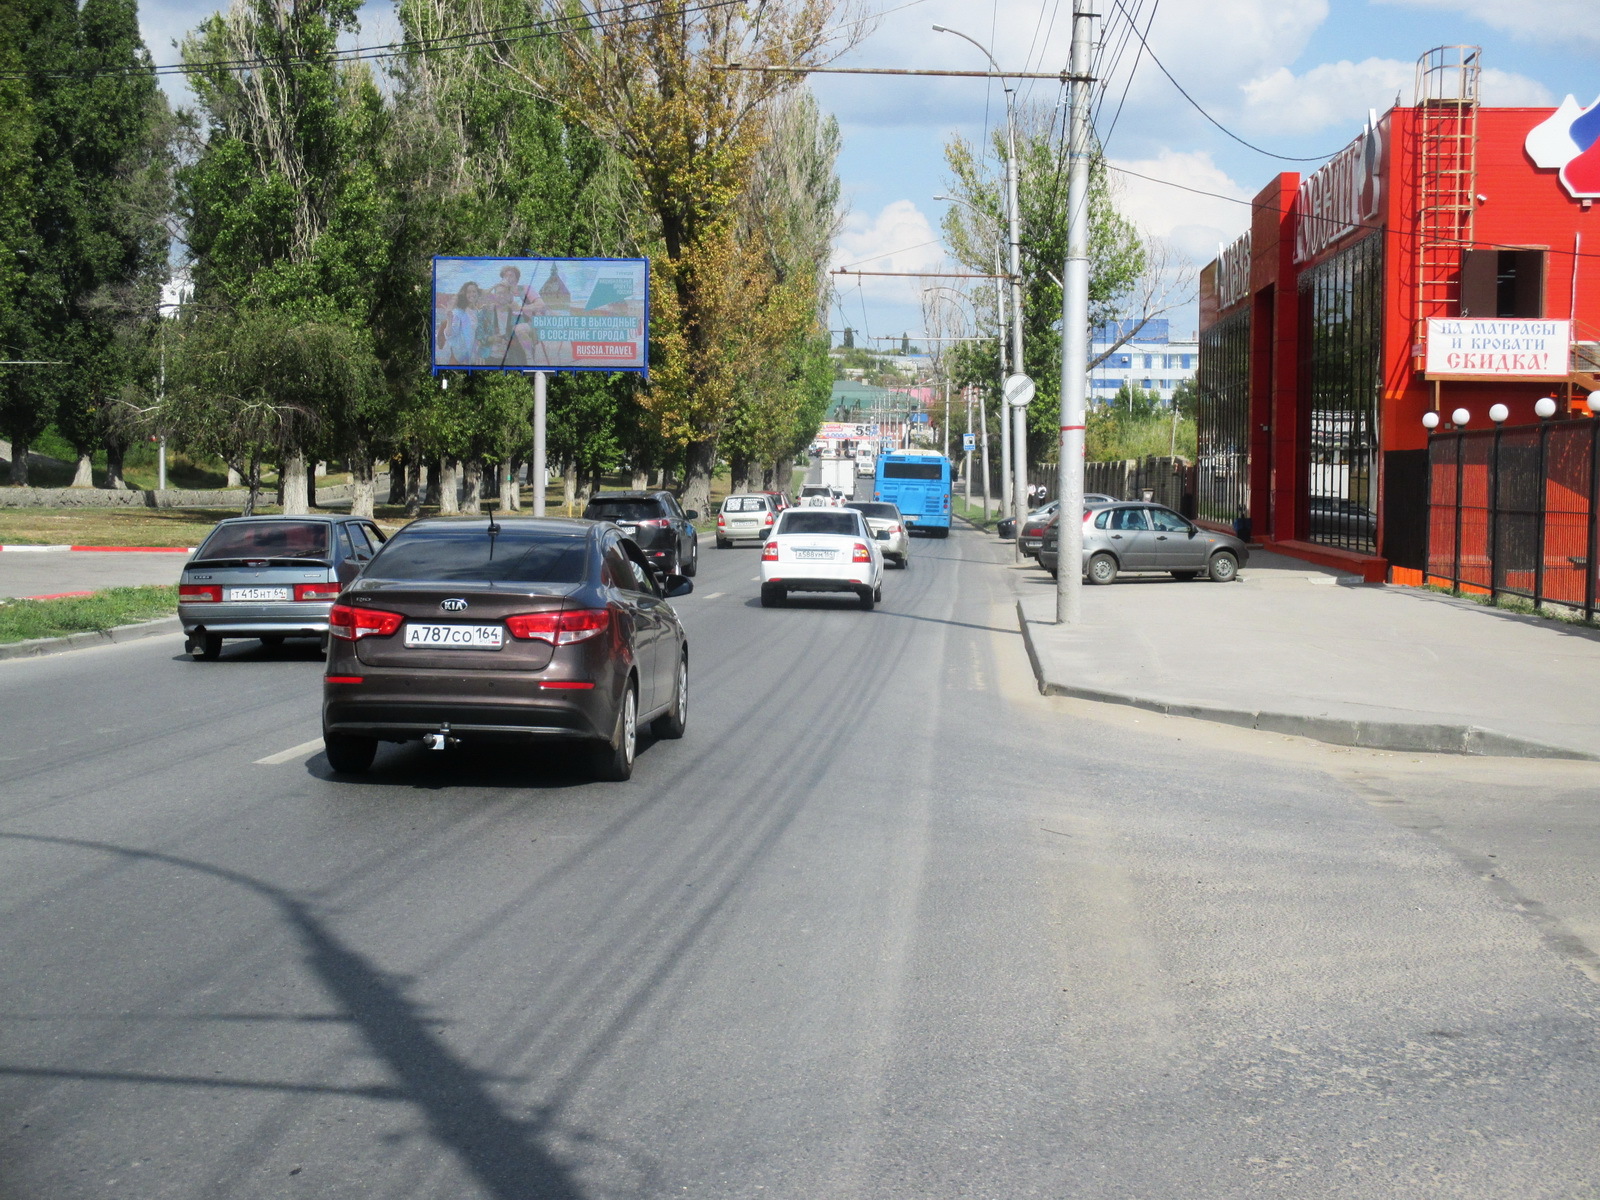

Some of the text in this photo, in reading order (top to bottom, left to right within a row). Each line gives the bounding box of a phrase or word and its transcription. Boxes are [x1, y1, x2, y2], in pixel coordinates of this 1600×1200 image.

[533, 317, 637, 328] ВЫХОДИТЕ В ВЫХОДНЫЕ
[1441, 322, 1556, 336] НА МАТРАСЫ
[540, 330, 625, 341] В СОСЕДНИЕ ГОРОДА
[1452, 338, 1545, 350] И КРОВАТИ
[1447, 352, 1549, 372] СКИДКА!
[235, 588, 284, 599] Т415НТ 64
[444, 601, 463, 610] KIA
[411, 626, 498, 643] А787СО 164
